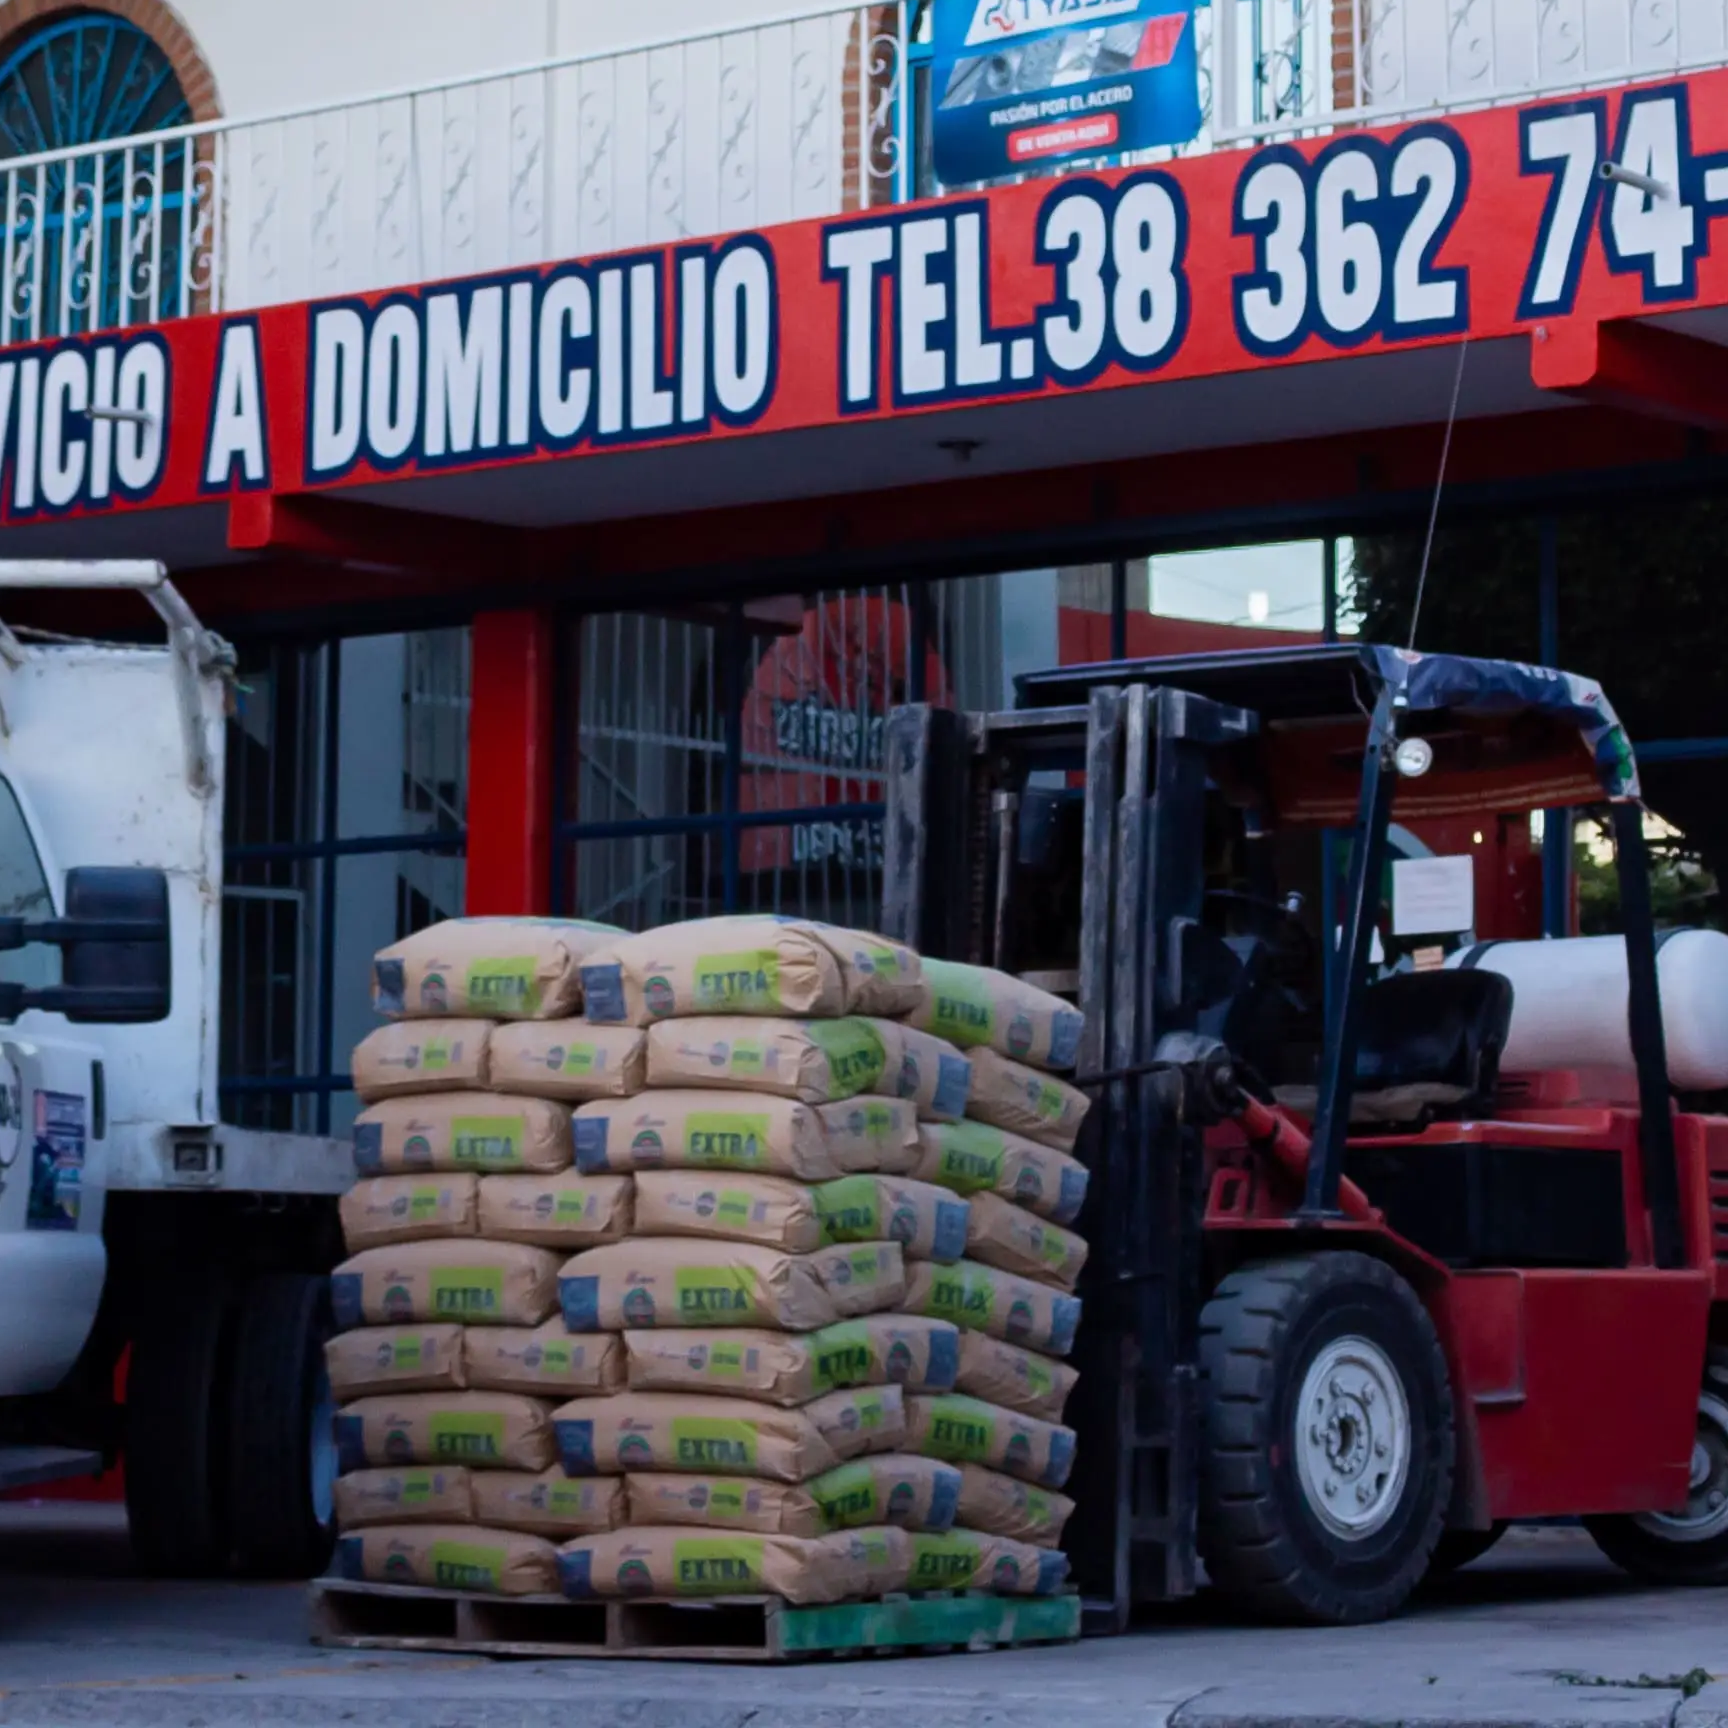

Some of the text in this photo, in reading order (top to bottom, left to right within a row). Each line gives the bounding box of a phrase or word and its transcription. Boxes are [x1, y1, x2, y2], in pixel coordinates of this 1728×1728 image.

[206, 322, 265, 484] A
[310, 246, 772, 472] DOMICILIO
[1238, 136, 1459, 345] 362
[700, 969, 769, 996] EXTRA
[936, 996, 990, 1029] EXTRA
[690, 1132, 758, 1157] EXTRA
[436, 1286, 495, 1310] EXTRA
[680, 1286, 749, 1311] EXTRA
[436, 1432, 498, 1456] EXTRA
[932, 1417, 988, 1446] EXTRA
[678, 1437, 750, 1464] EXTRA
[680, 1558, 751, 1583] EXTRA
